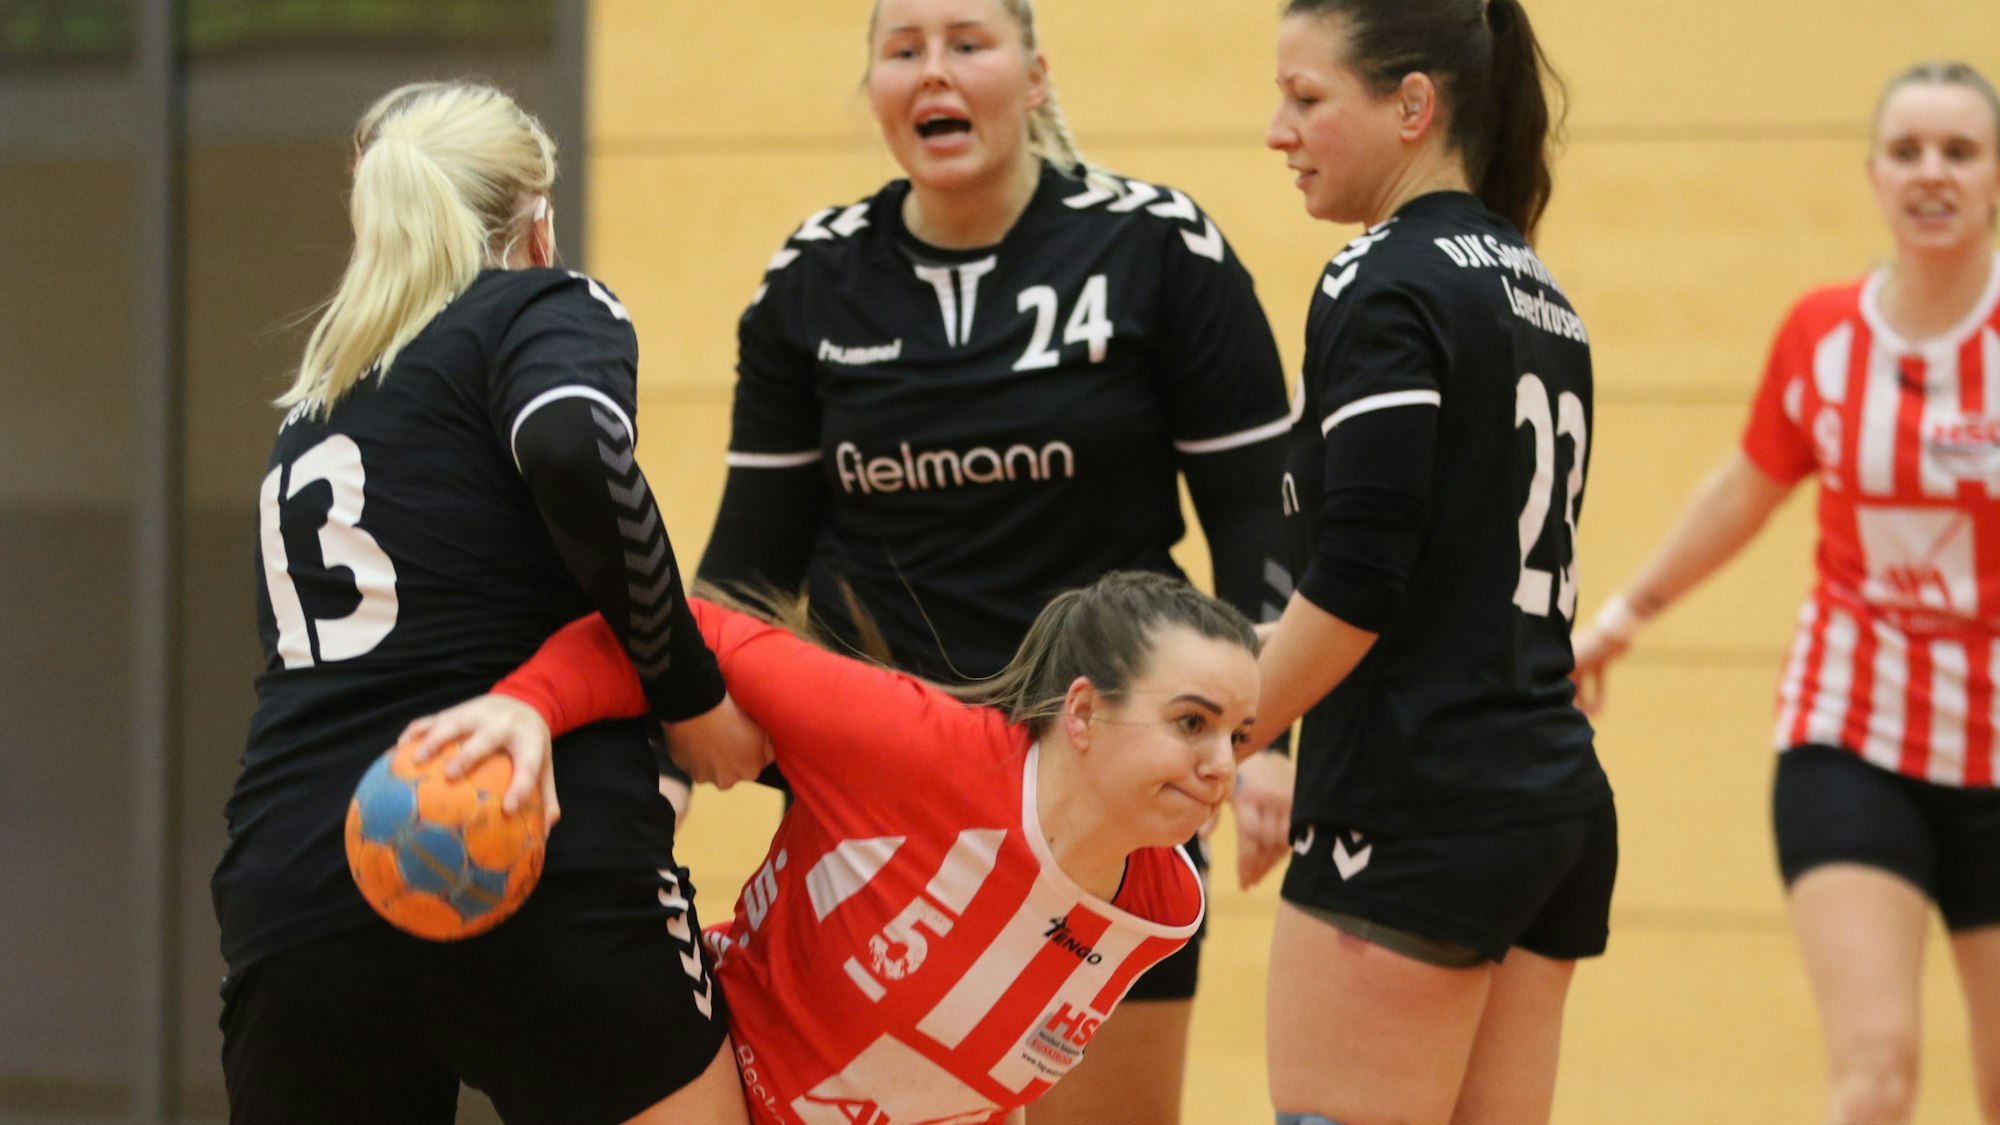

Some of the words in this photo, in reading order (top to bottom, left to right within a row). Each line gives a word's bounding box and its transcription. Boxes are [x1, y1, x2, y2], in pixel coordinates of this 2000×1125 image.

[1433, 233, 1499, 268] DJK
[1012, 274, 1114, 372] 24
[817, 338, 902, 366] hummel
[836, 441, 1075, 495] fielmann
[1511, 372, 1587, 624] 23
[259, 433, 400, 670] 13
[1045, 1002, 1100, 1048] HS
